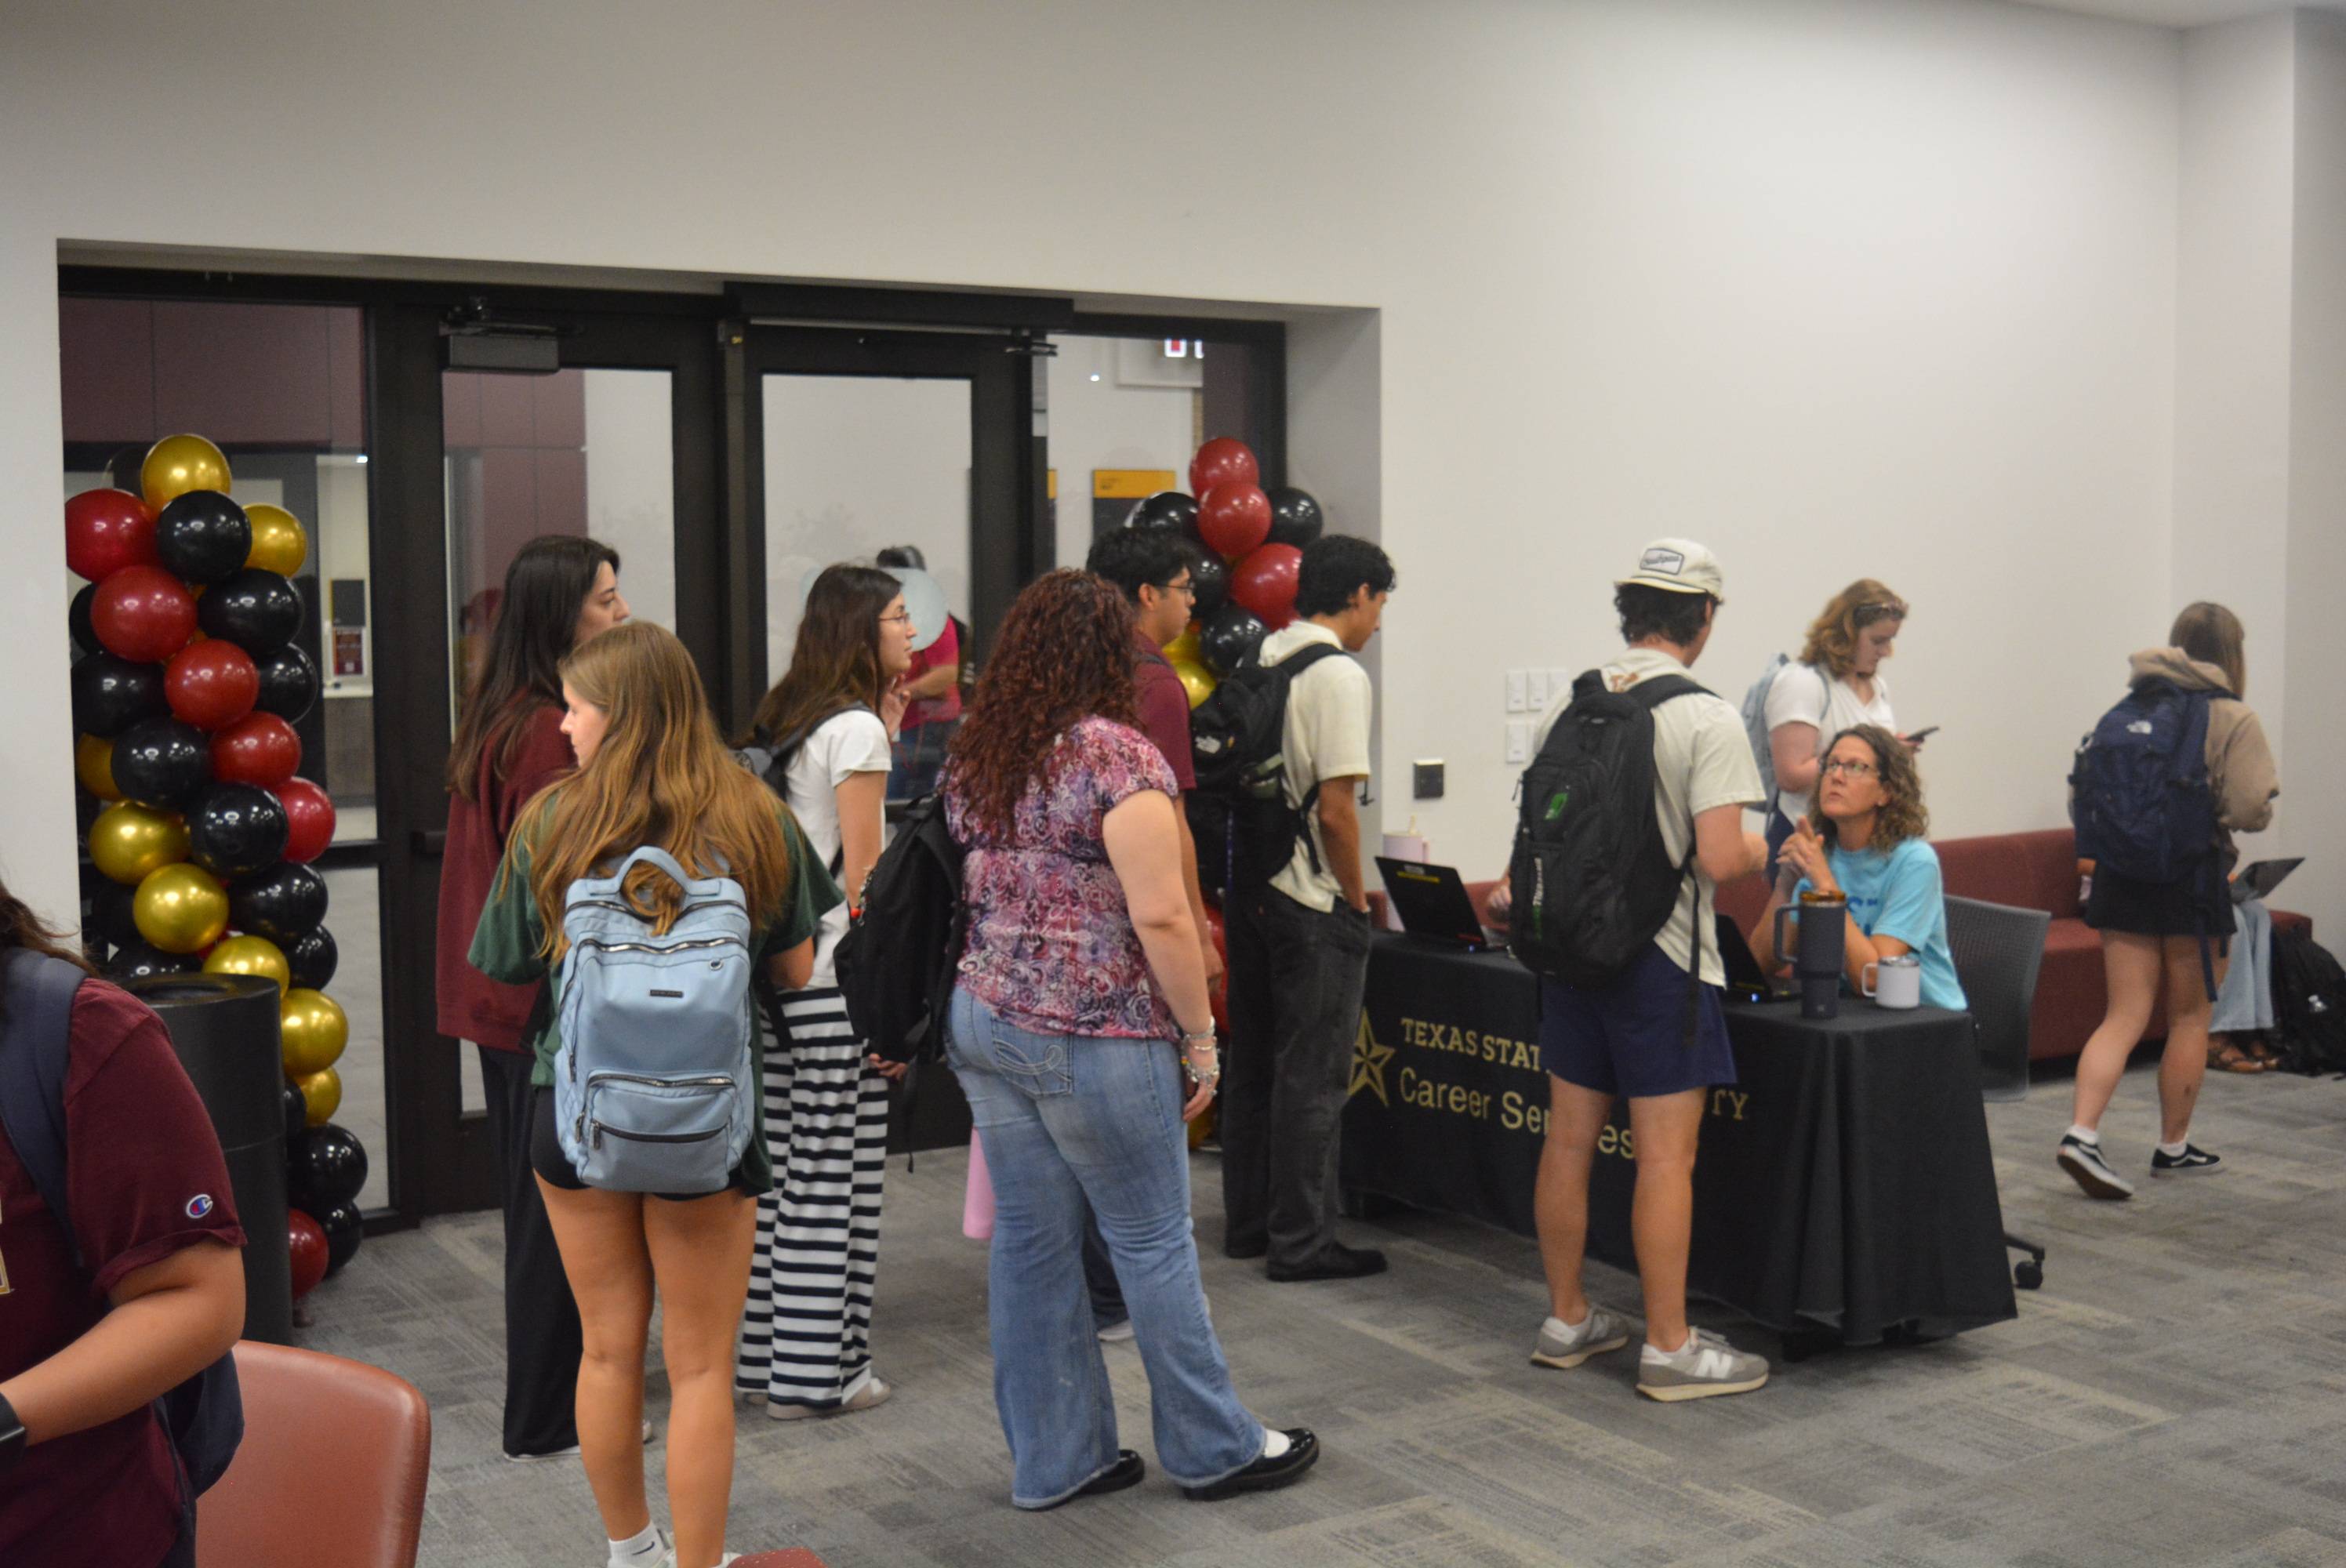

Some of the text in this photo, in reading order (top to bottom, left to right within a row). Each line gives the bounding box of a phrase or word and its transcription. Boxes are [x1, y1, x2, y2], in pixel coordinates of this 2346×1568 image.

[1401, 1018, 1549, 1072] TEXAS STAT
[1400, 1066, 1490, 1120] Career
